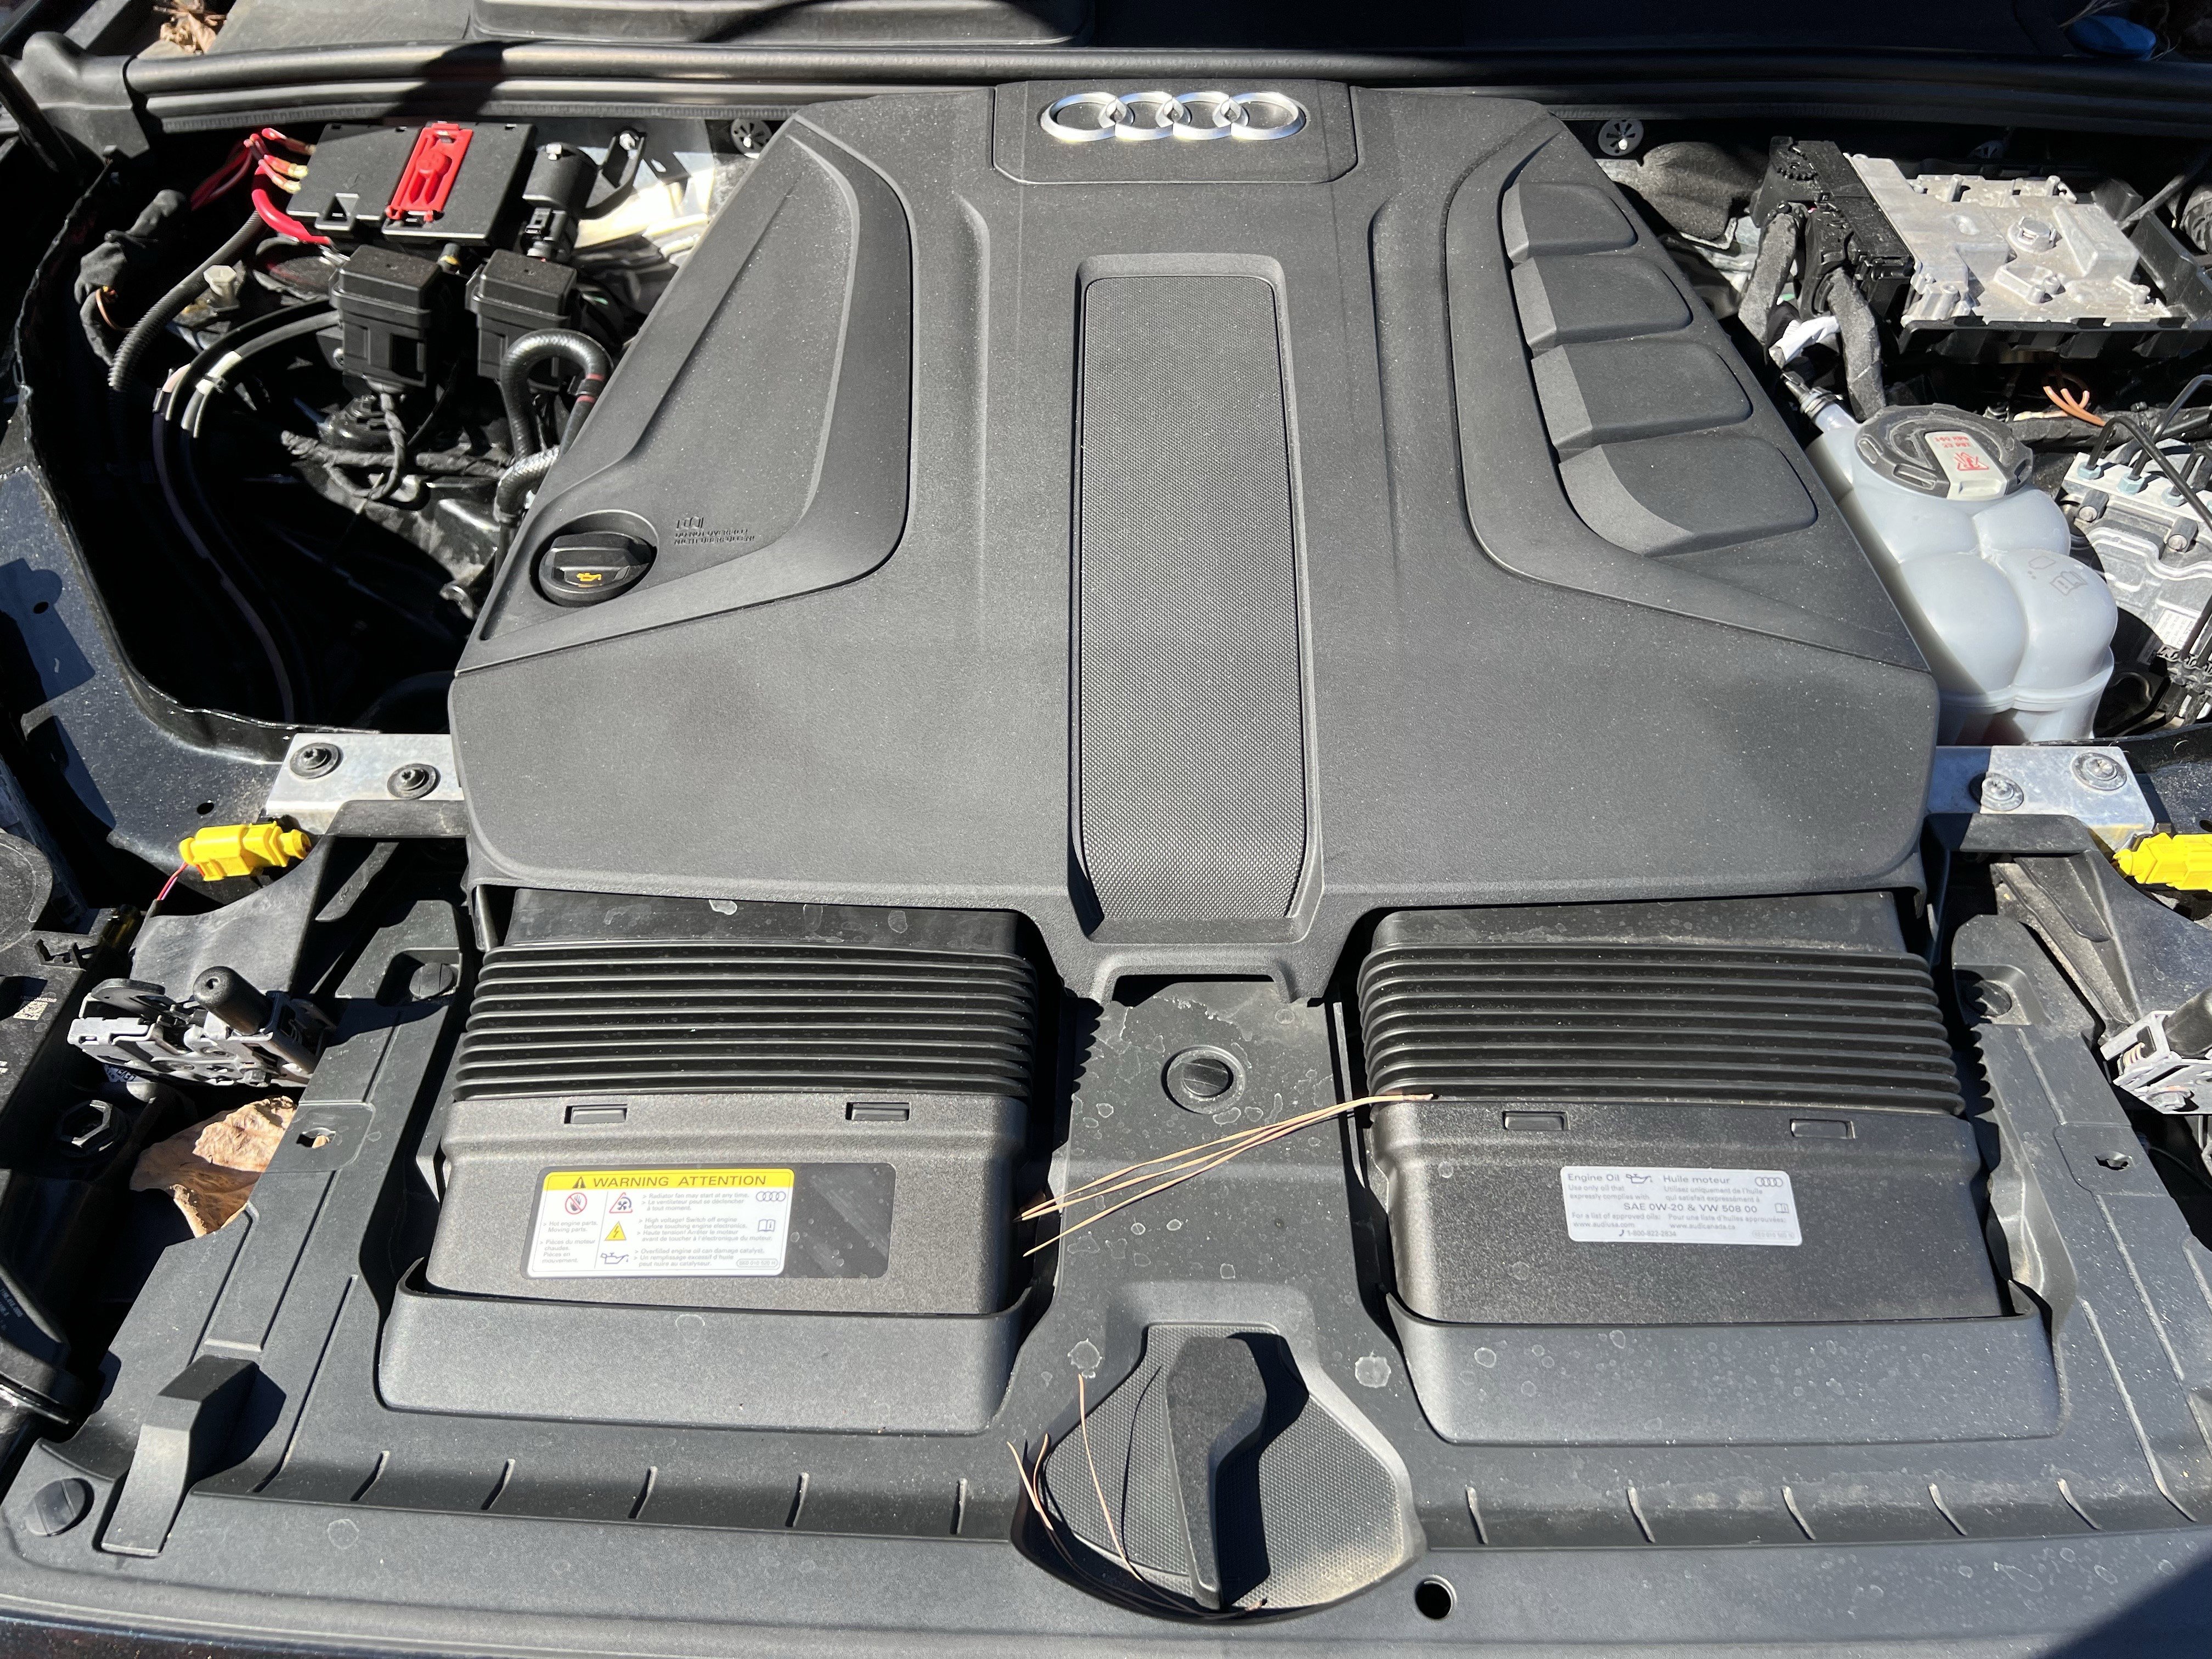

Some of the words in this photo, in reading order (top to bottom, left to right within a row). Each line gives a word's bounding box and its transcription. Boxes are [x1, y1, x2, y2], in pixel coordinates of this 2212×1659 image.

[593, 1176, 669, 1187] WARNING
[678, 1175, 767, 1186] ATTENTION
[1568, 1173, 1602, 1182] Engine
[1663, 1175, 1689, 1183] Huile
[1649, 1203, 1684, 1211] 0W-20
